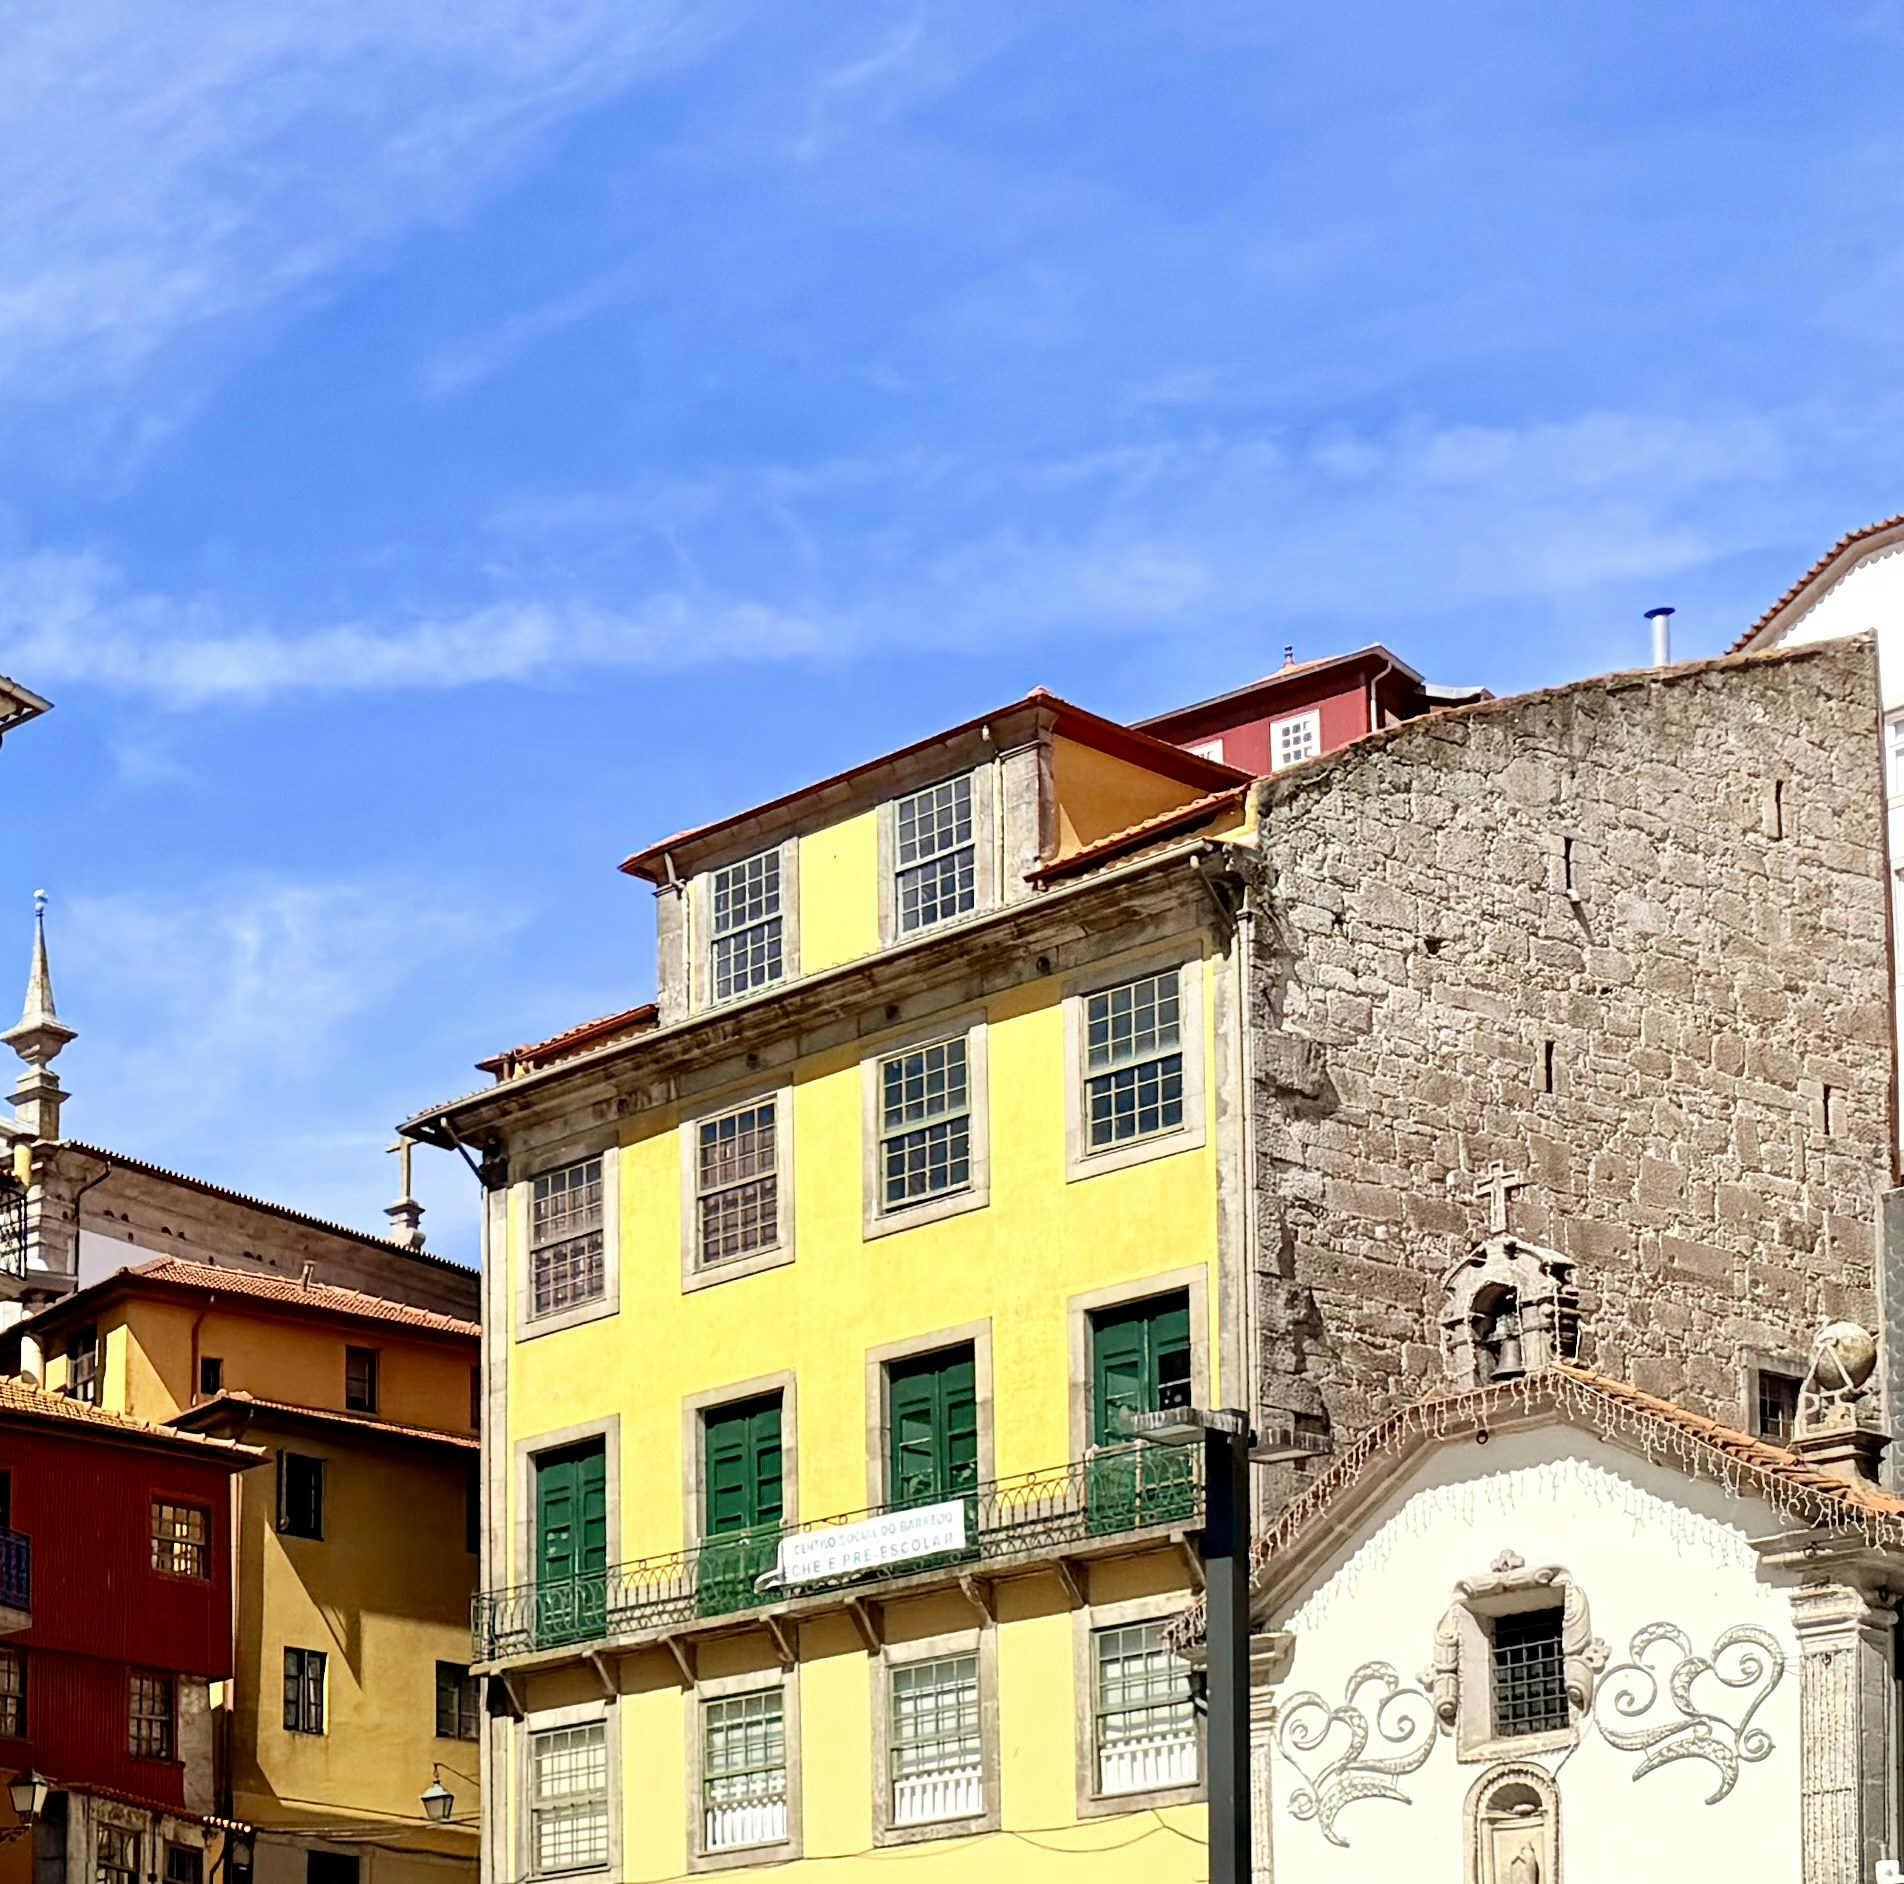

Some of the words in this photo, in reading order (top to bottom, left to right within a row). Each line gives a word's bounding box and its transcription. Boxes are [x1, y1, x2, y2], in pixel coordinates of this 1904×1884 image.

[794, 1535, 836, 1556] CENTRO
[881, 1522, 896, 1536] DO
[900, 1511, 953, 1531] BARREDO
[828, 1558, 837, 1570] E
